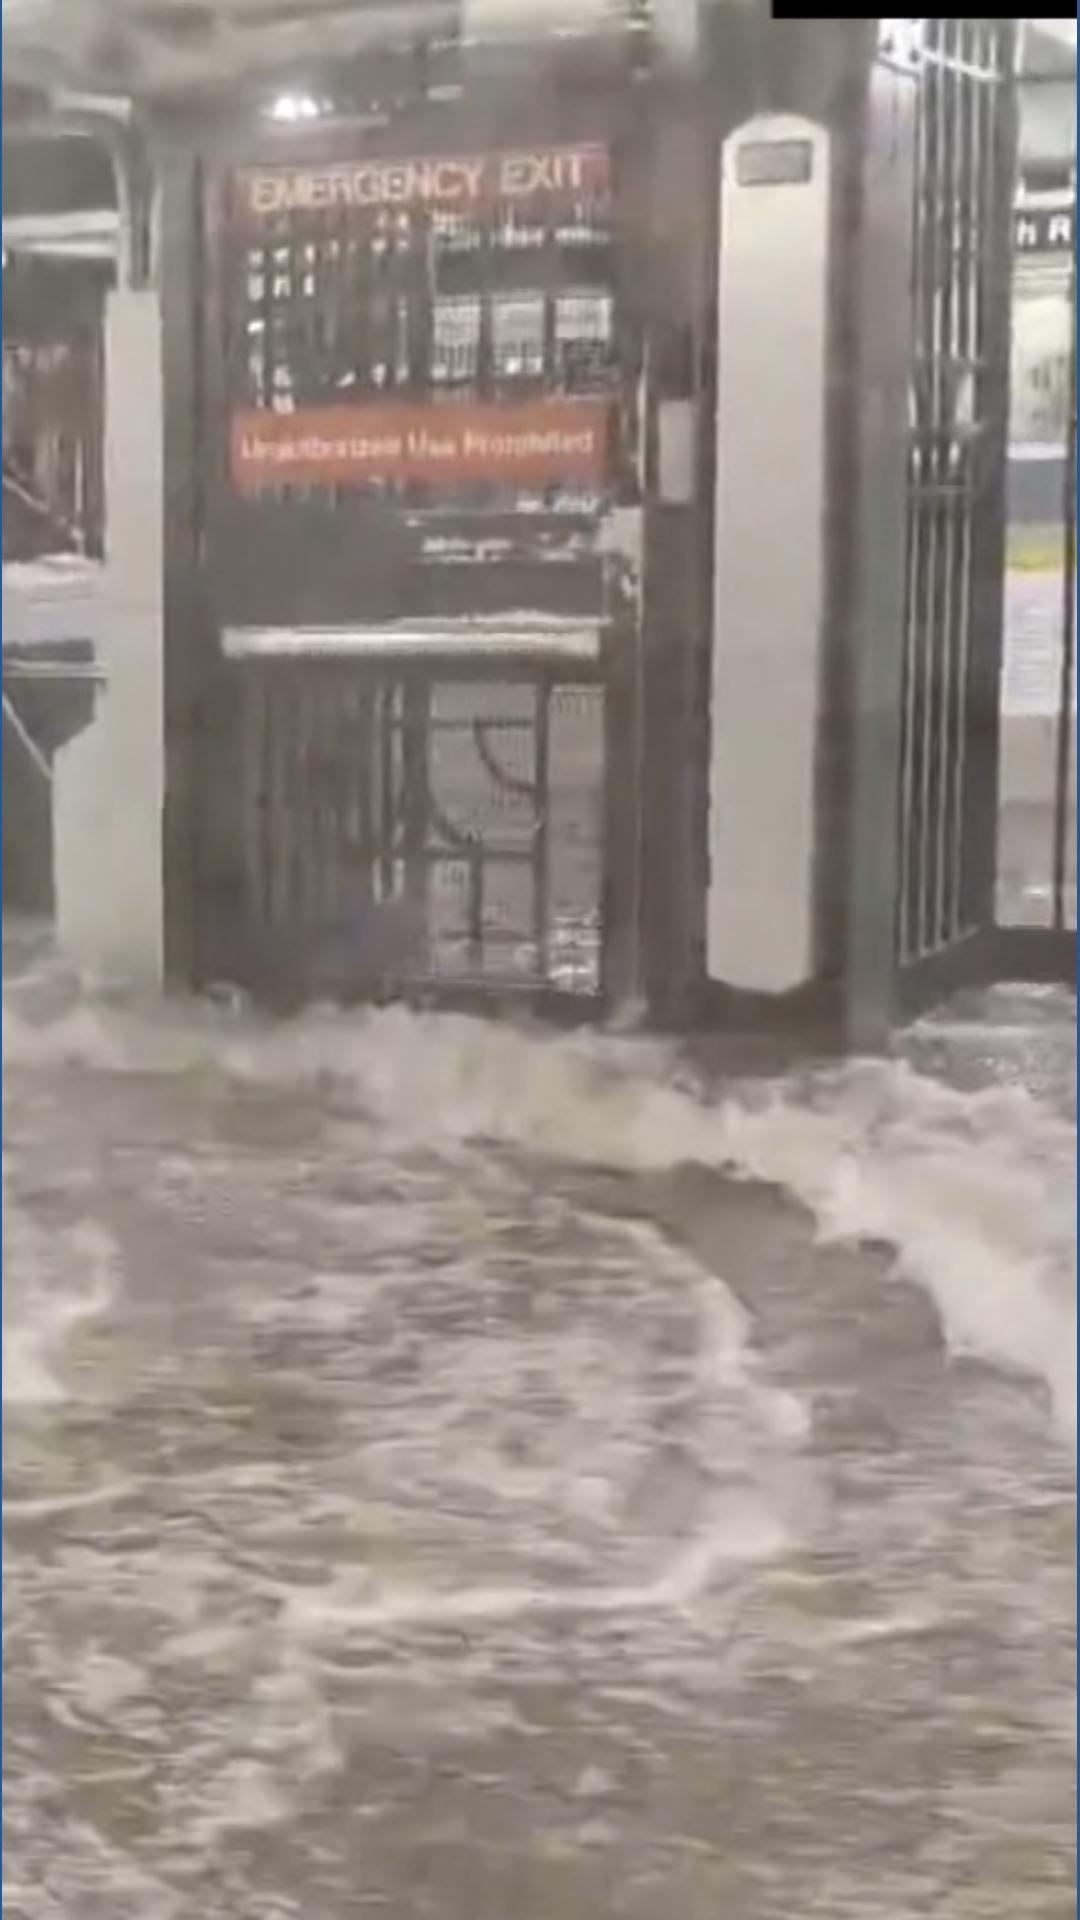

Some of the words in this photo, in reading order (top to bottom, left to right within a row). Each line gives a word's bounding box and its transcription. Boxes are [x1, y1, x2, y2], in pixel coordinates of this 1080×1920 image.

[252, 162, 485, 212] EMERGENCY
[501, 154, 584, 194] EXIT
[407, 430, 458, 457] Use
[463, 430, 595, 457] Prohibited
